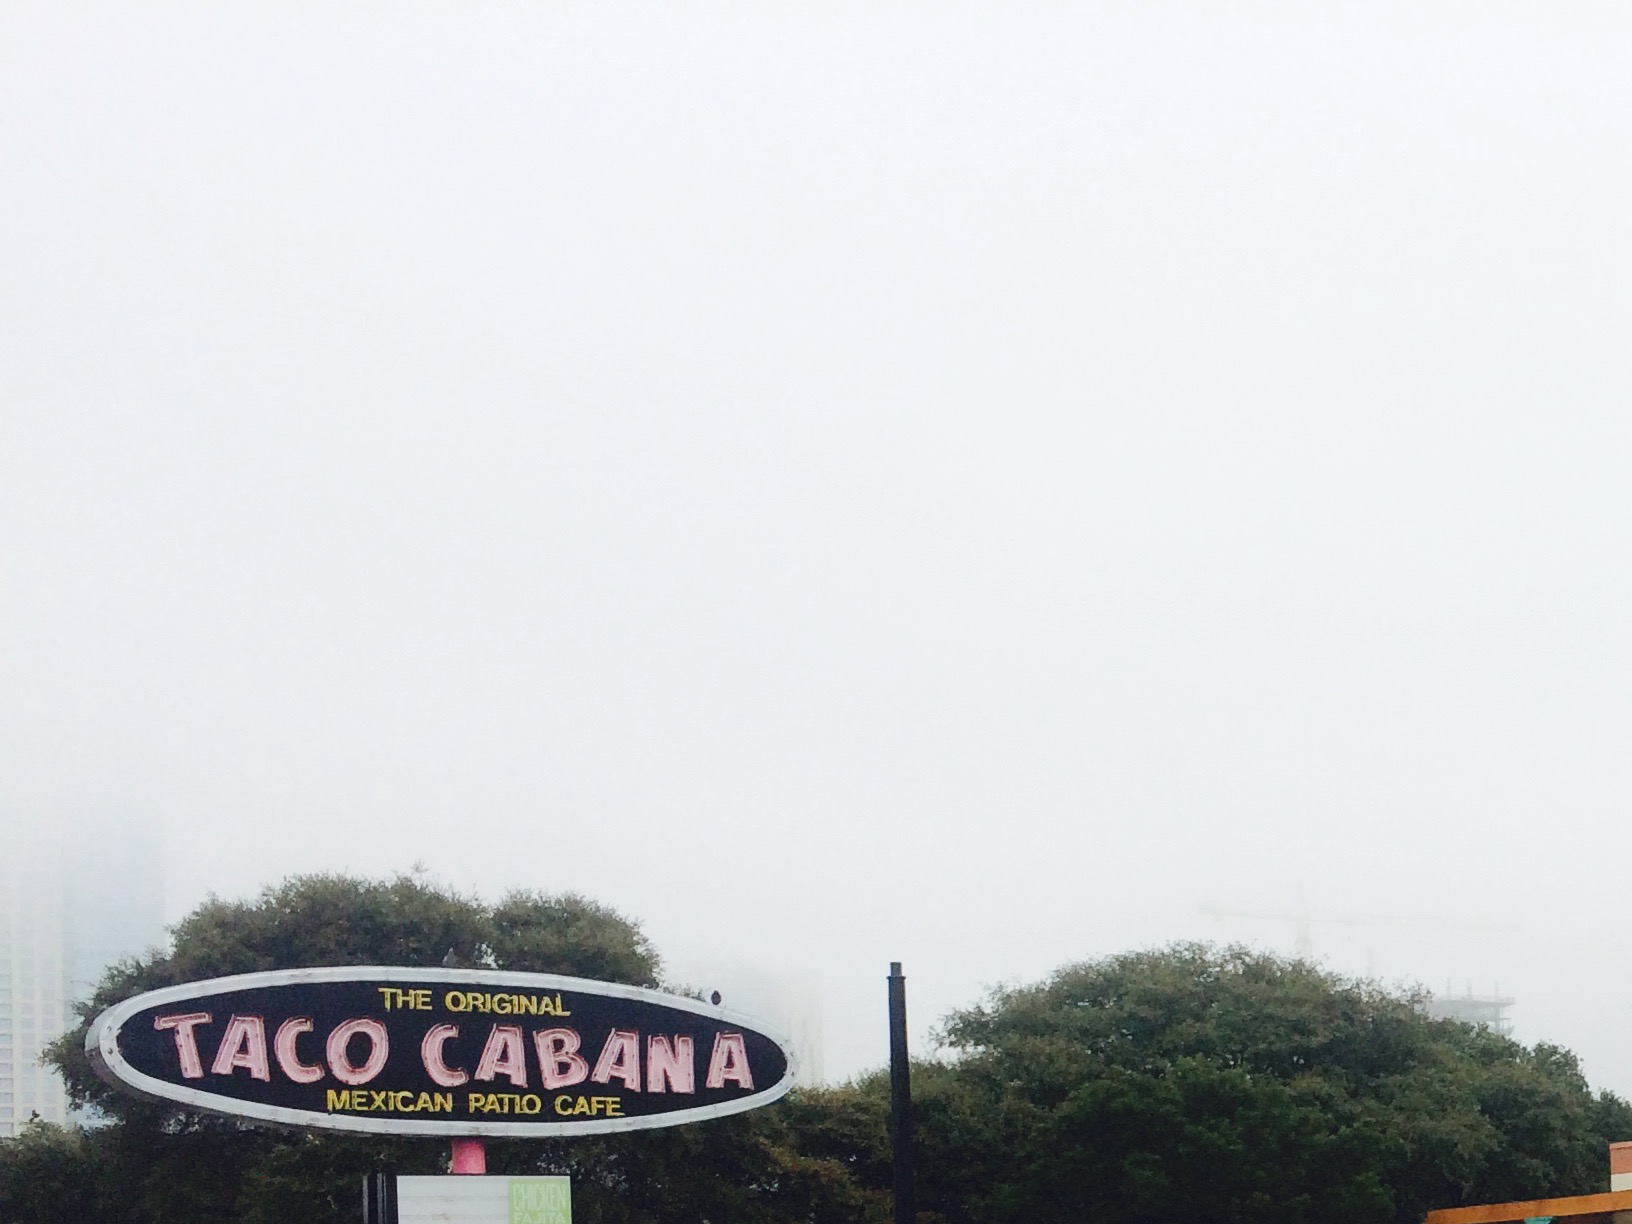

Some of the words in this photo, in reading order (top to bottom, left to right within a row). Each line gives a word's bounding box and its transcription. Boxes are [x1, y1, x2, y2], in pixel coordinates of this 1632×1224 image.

[378, 987, 433, 1011] THE
[445, 990, 571, 1017] ORIGINAL
[154, 1011, 390, 1086] TACO
[421, 1022, 755, 1095] CABANA
[327, 1088, 453, 1113] MEXICAN
[468, 1093, 542, 1115] PATIO
[554, 1095, 625, 1117] CAFE
[513, 1183, 567, 1211] CHICKEN
[513, 1211, 566, 1224] FAJITA
